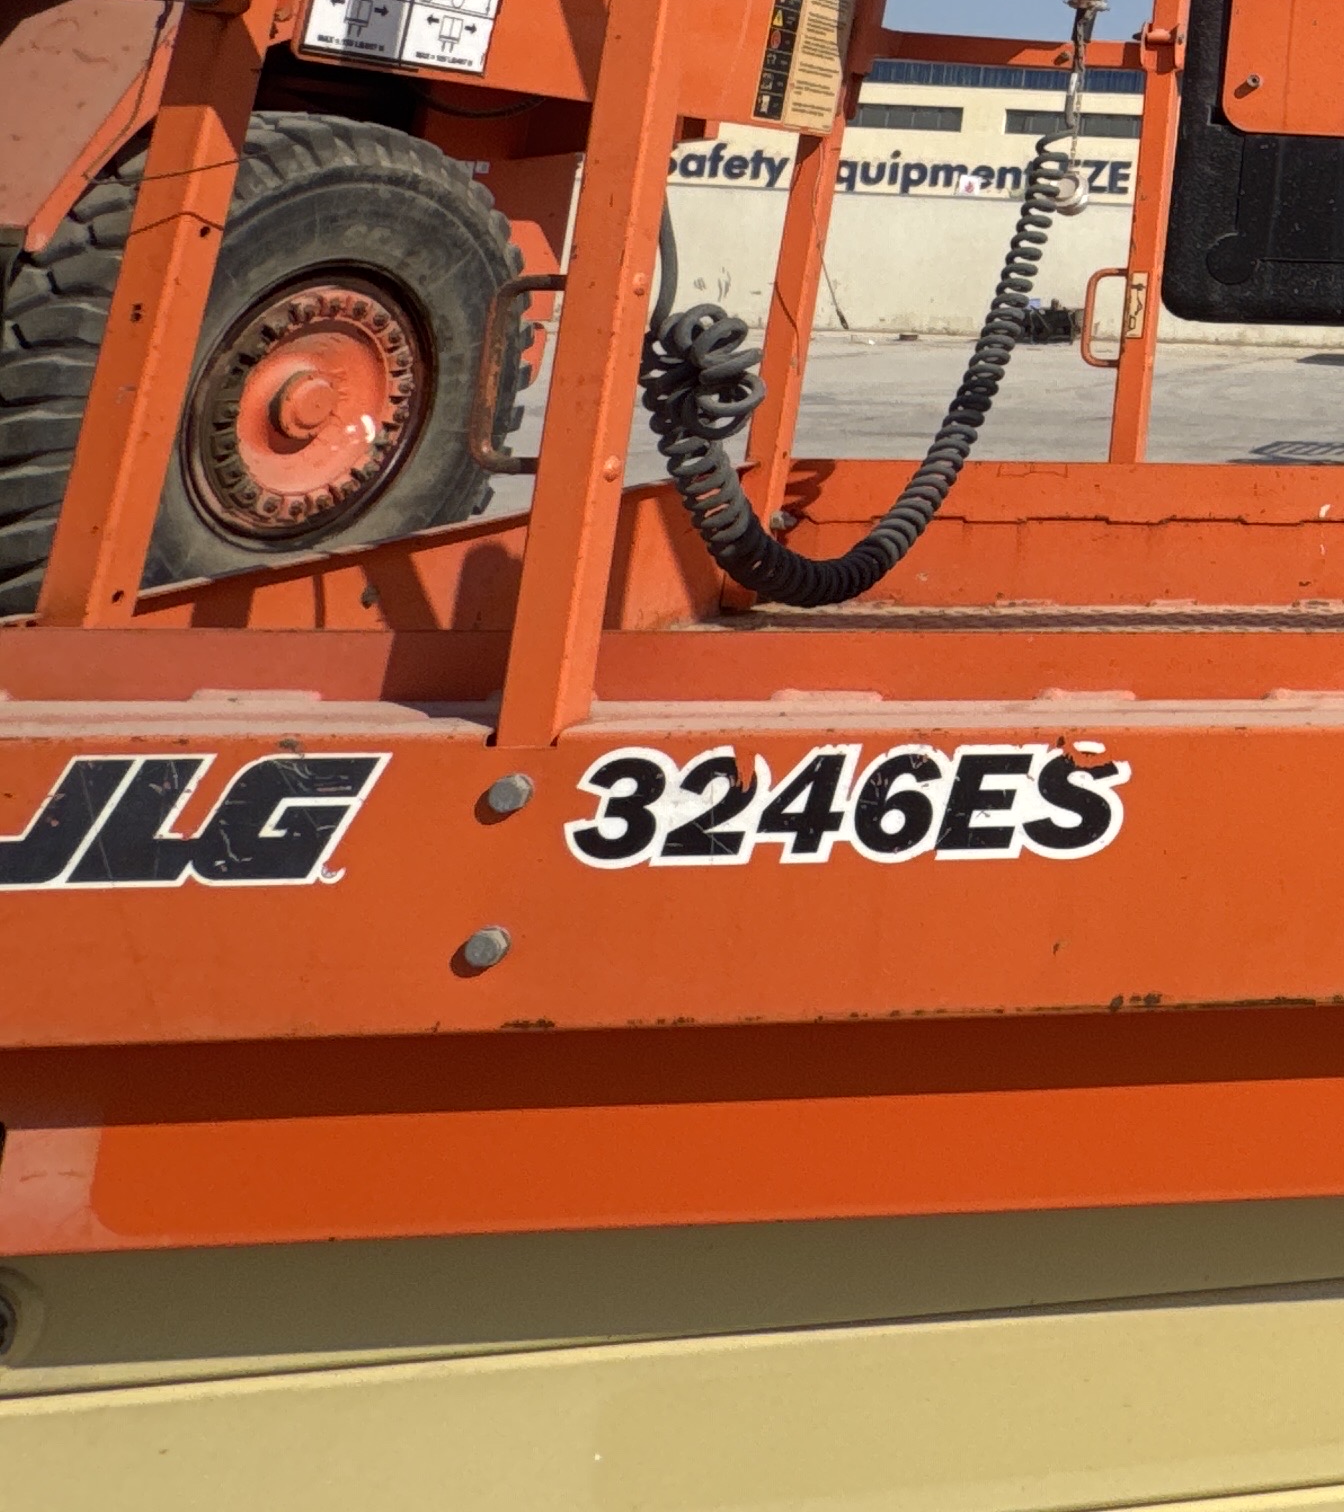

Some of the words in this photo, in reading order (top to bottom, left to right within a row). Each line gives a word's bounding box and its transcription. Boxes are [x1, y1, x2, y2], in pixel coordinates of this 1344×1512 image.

[668, 142, 790, 188] afety
[0, 753, 393, 887] JLG
[564, 744, 1132, 869] 3246ES
